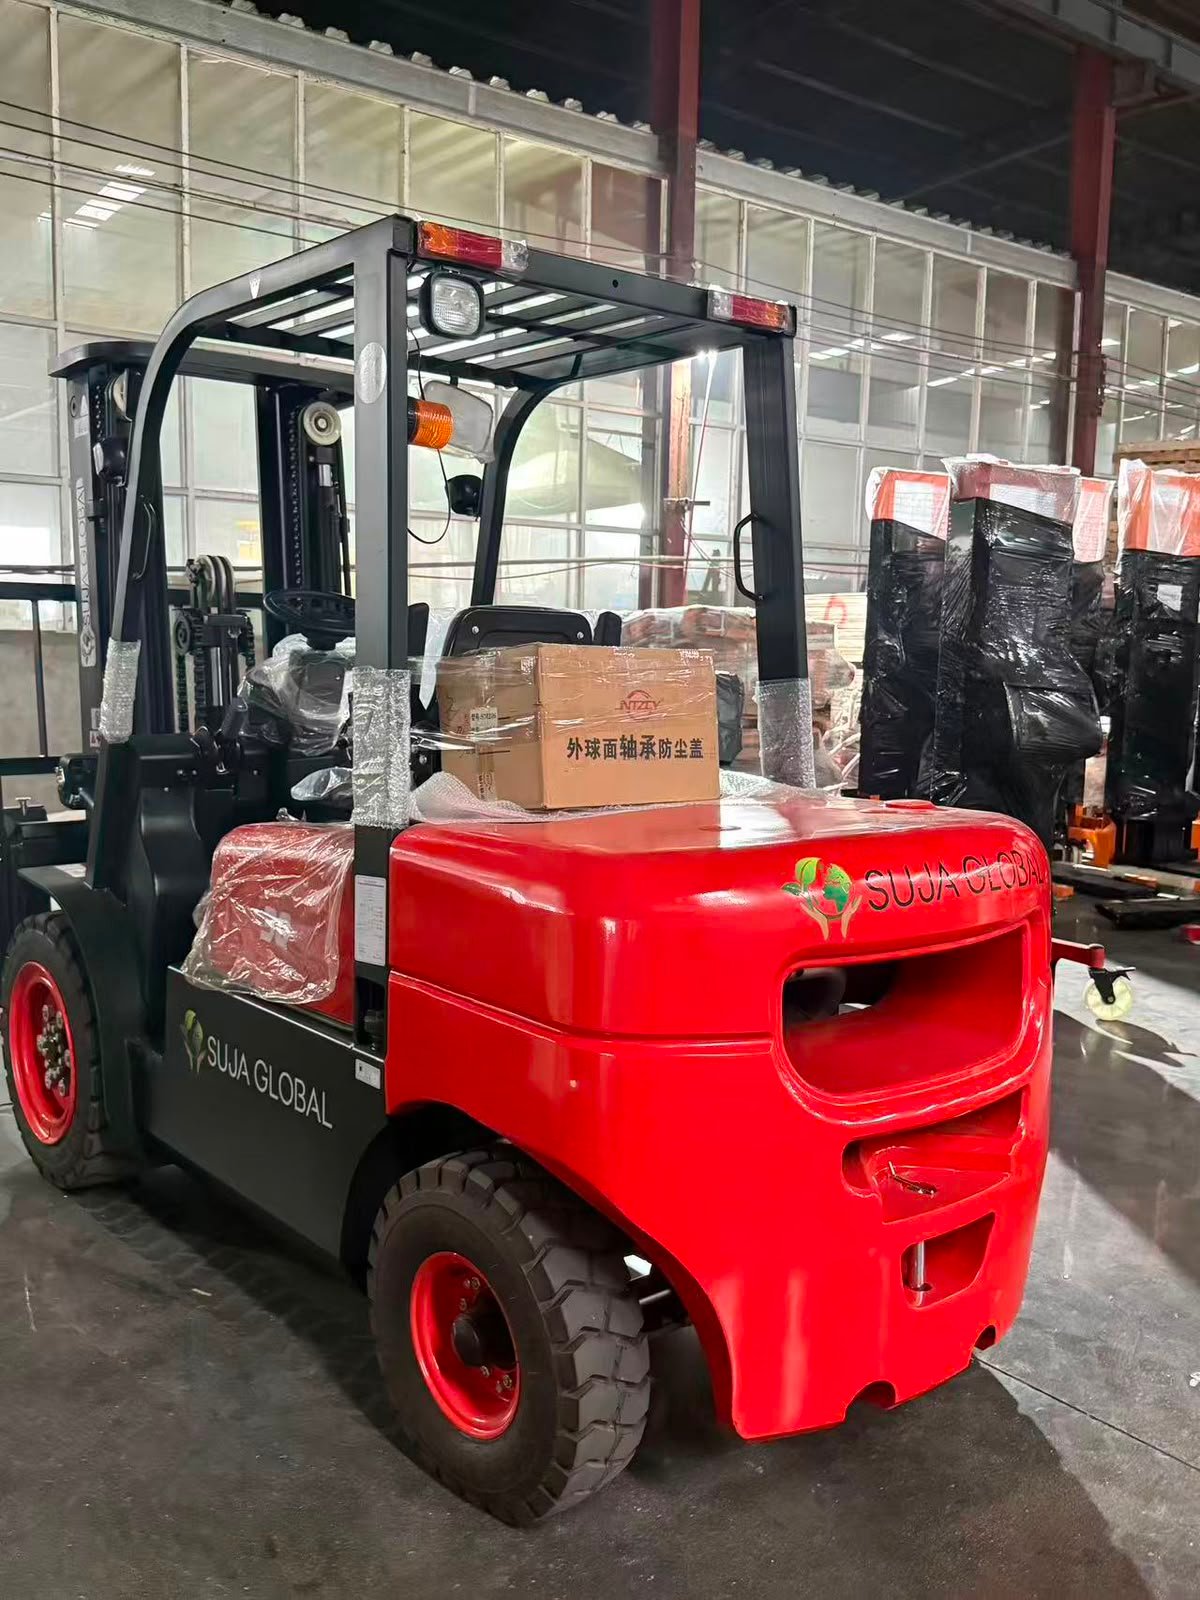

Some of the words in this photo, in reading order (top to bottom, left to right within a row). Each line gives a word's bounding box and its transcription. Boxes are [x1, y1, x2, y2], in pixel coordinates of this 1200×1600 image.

[567, 735, 704, 760] 外球面轴承防尘盖
[864, 862, 960, 911] SUJA
[963, 851, 1044, 894] GLOBAL
[207, 1036, 250, 1086] SUJA
[254, 1059, 333, 1129] GLOBAL
